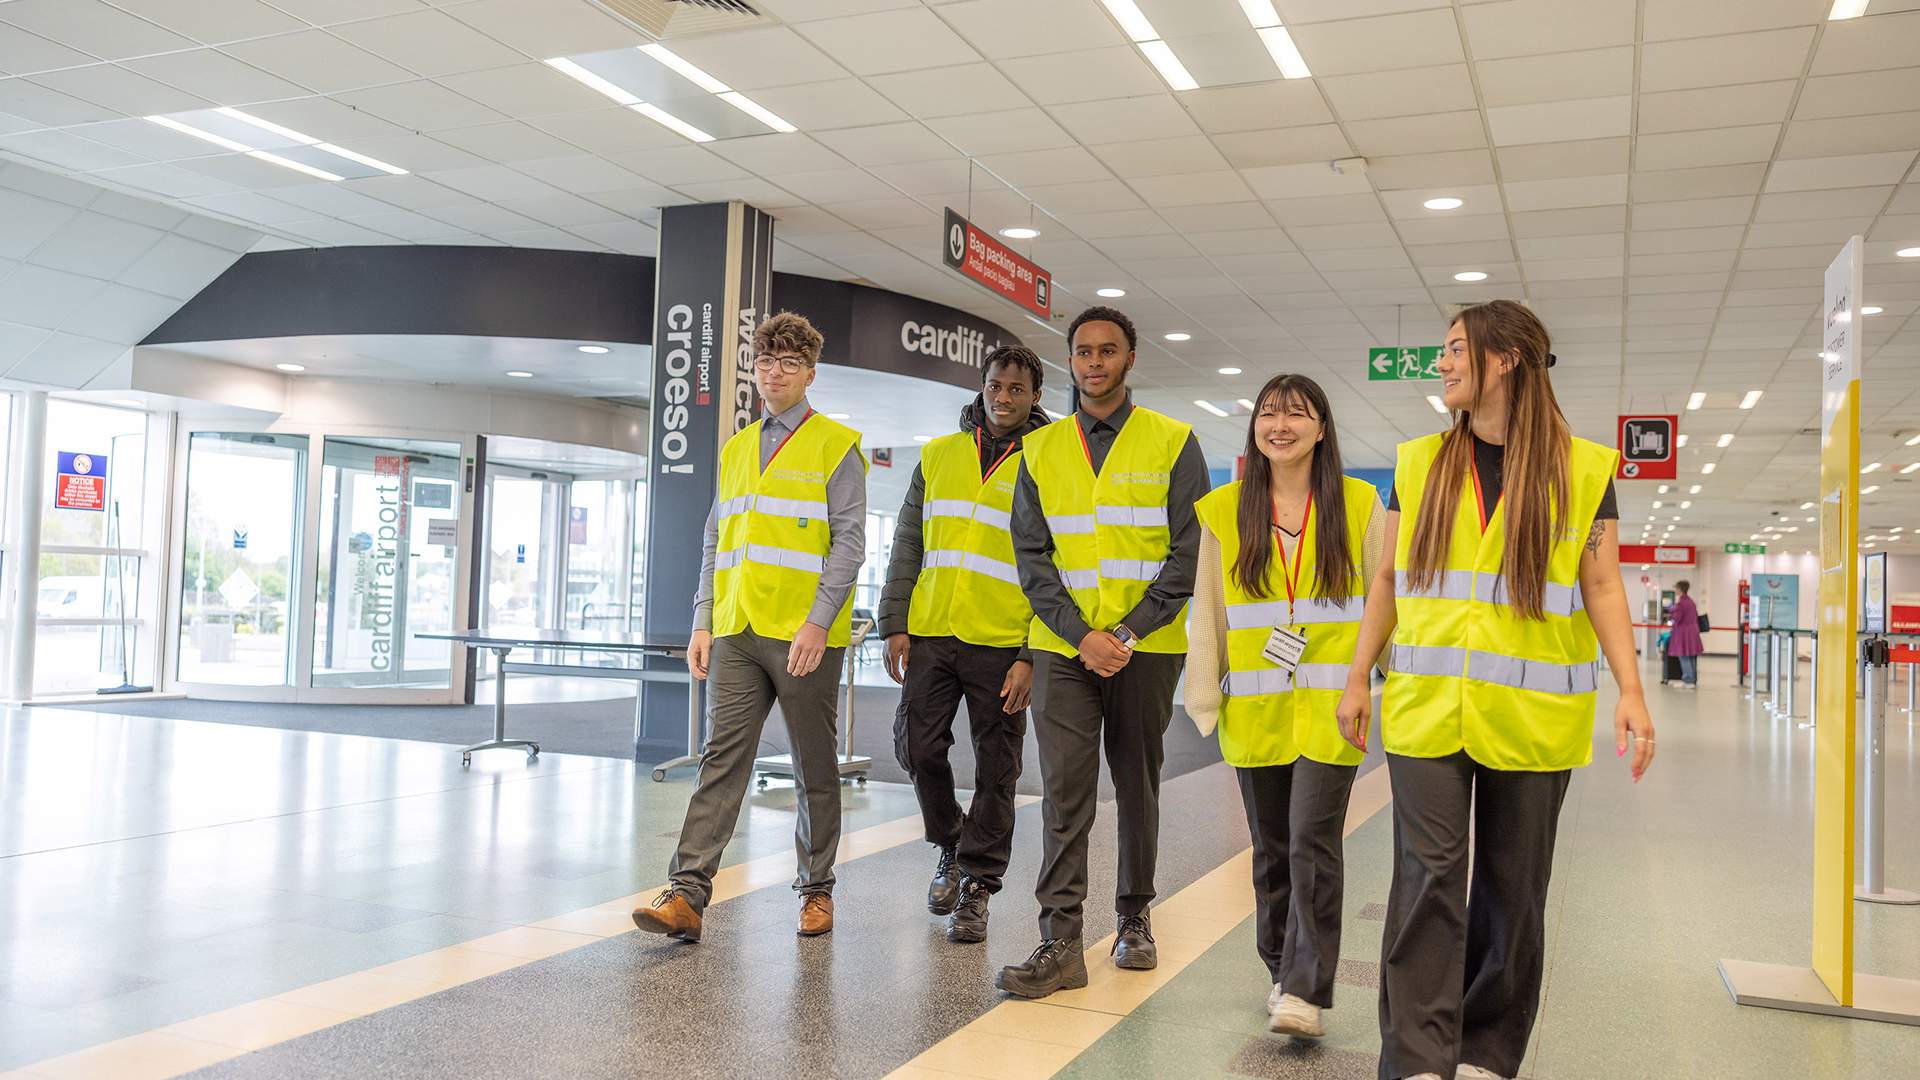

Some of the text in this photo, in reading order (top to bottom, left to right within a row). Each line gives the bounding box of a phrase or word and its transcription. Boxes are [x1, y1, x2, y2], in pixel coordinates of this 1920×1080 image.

[969, 232, 1033, 284] Bag packing area
[661, 304, 694, 474] croeso!
[698, 302, 713, 392] cardiff airport
[735, 307, 757, 435] welco
[901, 320, 984, 369] cardiff
[69, 477, 94, 486] NOTICE
[368, 485, 400, 670] cardiff airport
